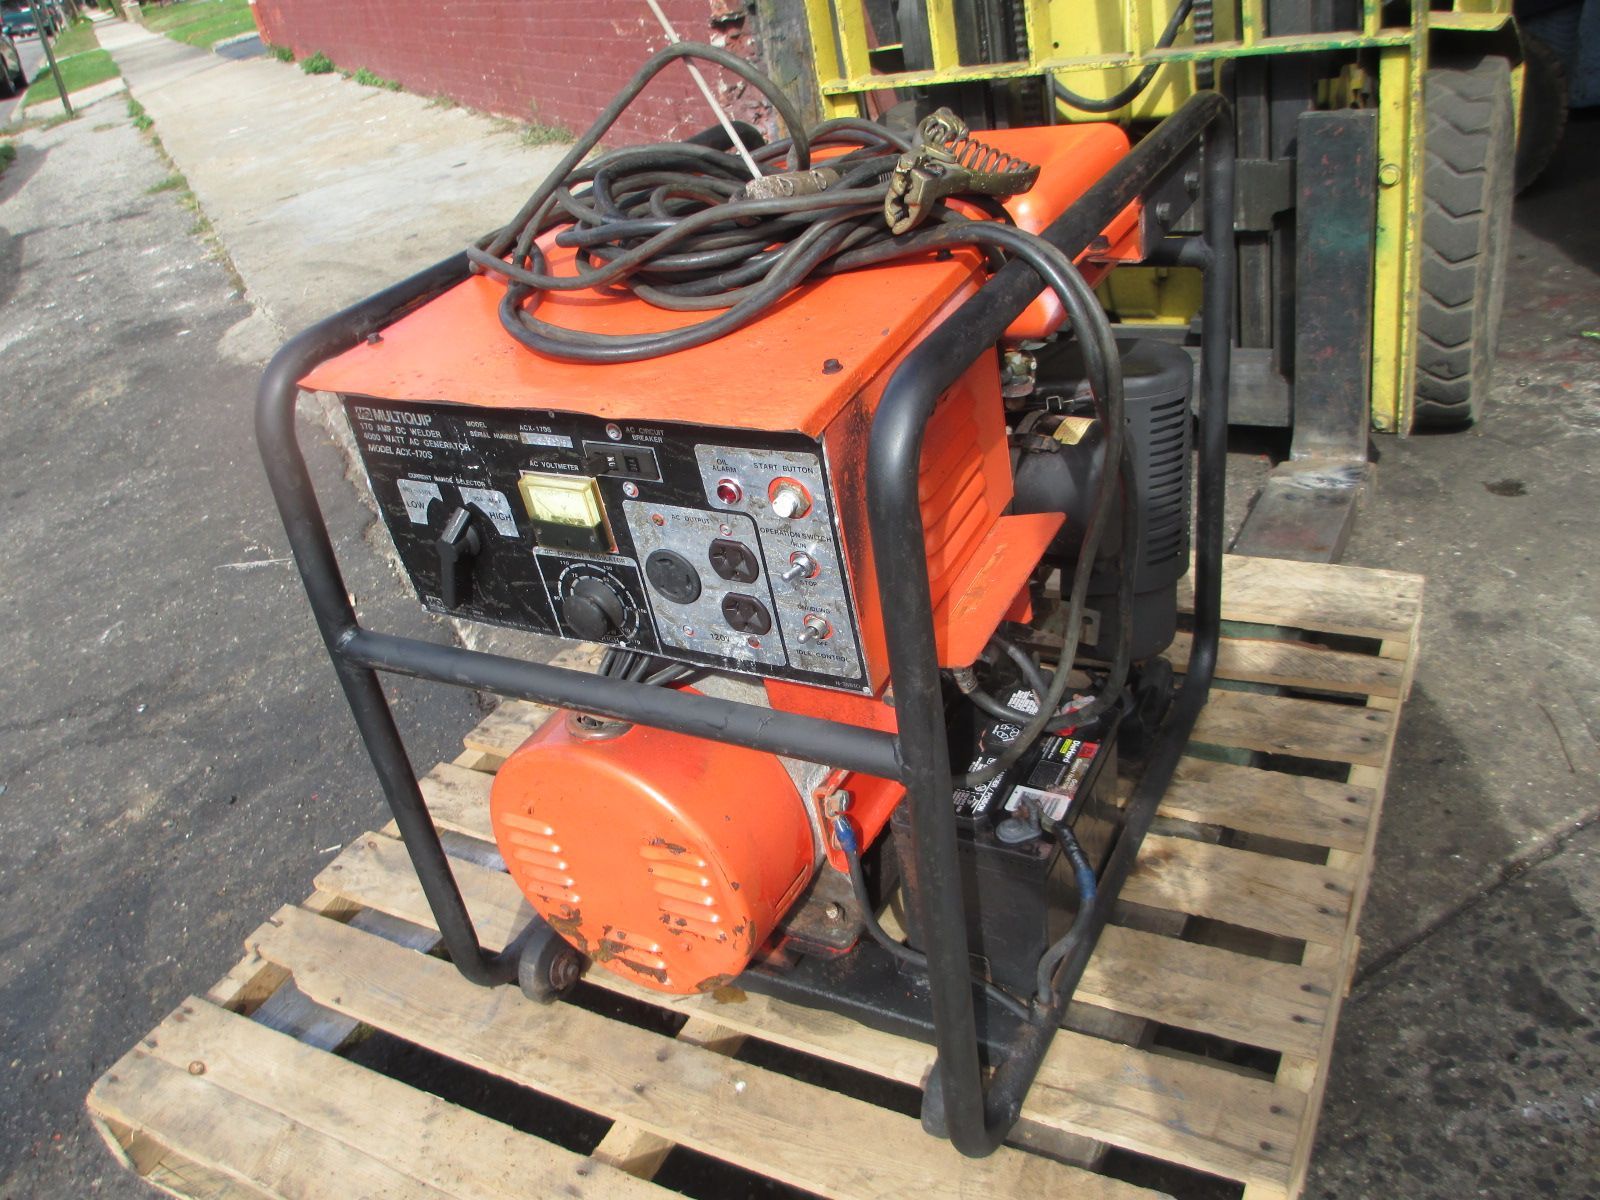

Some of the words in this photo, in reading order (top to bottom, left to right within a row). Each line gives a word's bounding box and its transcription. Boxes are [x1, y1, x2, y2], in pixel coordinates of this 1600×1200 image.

[372, 408, 432, 426] MULTIQUIP
[360, 422, 373, 431] 170
[396, 426, 407, 435] DC
[410, 428, 442, 438] WELDER
[465, 420, 488, 428] MODEL
[519, 424, 552, 433] ACX-170S
[638, 428, 664, 436] CIRCUIT
[469, 430, 491, 439] SERIAL
[493, 432, 519, 441] NUMBER
[631, 434, 664, 443] BREAKER
[363, 432, 381, 441] 4000
[384, 435, 405, 444] WATT
[409, 438, 420, 446] AC
[424, 440, 472, 451] GENERATOR
[368, 444, 394, 454] MODEL
[395, 447, 433, 459] ACX-170S
[541, 462, 579, 471] VOLTMETER
[716, 458, 729, 466] OIL
[712, 465, 737, 473] ALARM
[753, 463, 777, 471] START
[782, 466, 814, 474] BUTTON
[408, 472, 432, 481] CURRENT
[456, 477, 487, 487] SELECTOR
[407, 500, 425, 510] LOW
[489, 511, 513, 521] HIGH
[684, 516, 711, 524] OUTPUT
[760, 527, 801, 539] OPERATION
[802, 533, 832, 542] SWITCH
[799, 580, 818, 588] STOP
[710, 632, 730, 642] 120V
[796, 649, 812, 658] IDLE
[815, 652, 849, 662] CONTROL
[1062, 740, 1081, 764] DieHard
[976, 791, 993, 812] POISON
